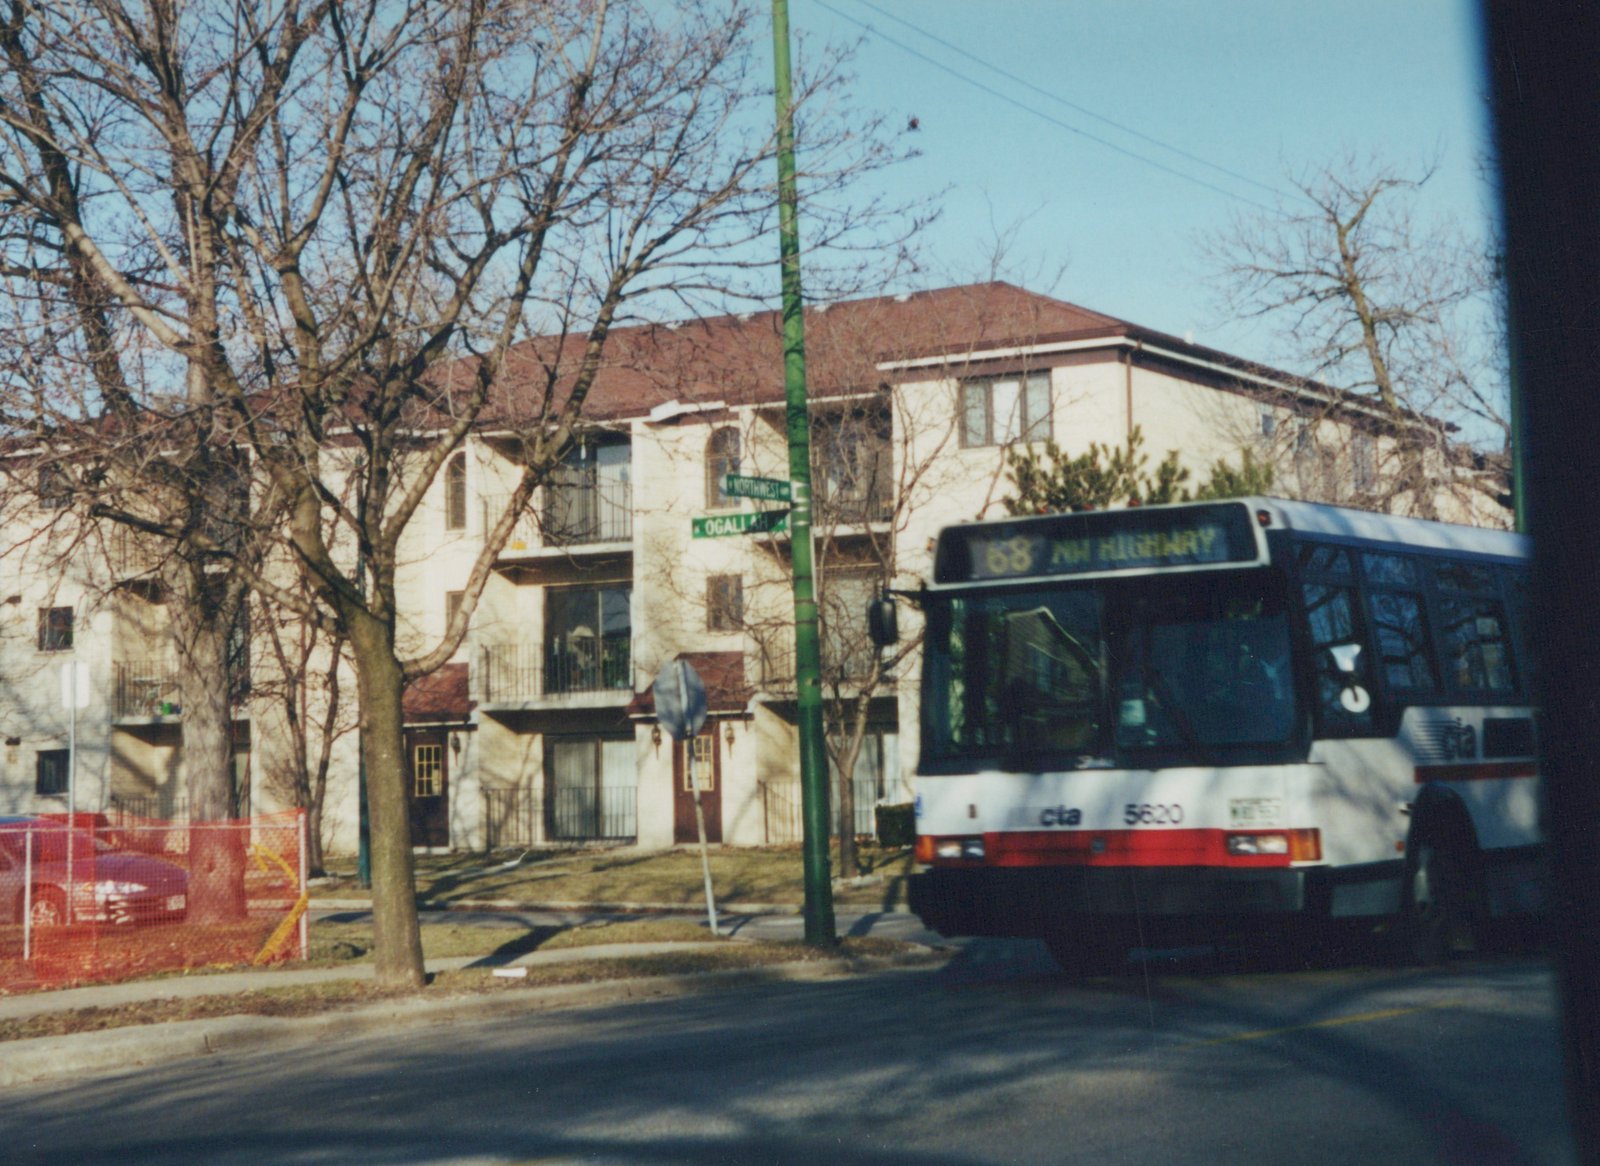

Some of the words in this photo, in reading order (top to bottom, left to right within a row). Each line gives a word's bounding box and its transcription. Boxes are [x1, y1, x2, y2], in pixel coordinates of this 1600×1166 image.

[734, 478, 779, 498] NORTHWEST
[986, 535, 1032, 573] 68
[1040, 804, 1082, 826] cta
[1123, 803, 1184, 825] 5620
